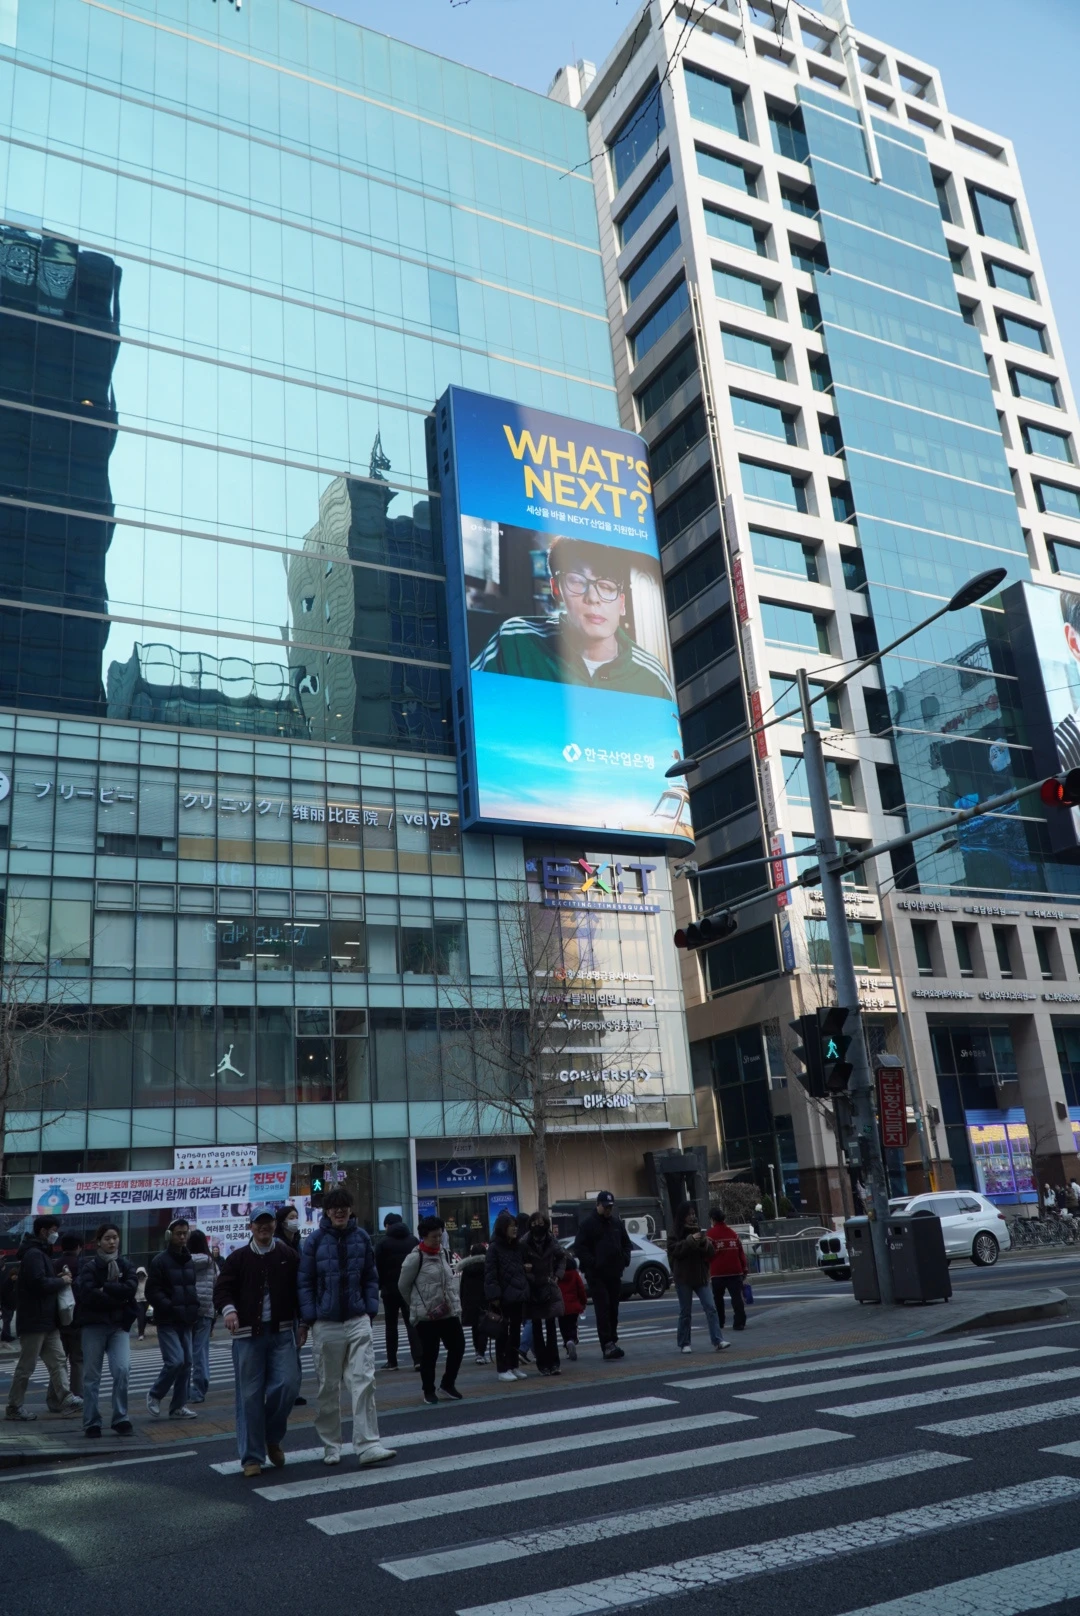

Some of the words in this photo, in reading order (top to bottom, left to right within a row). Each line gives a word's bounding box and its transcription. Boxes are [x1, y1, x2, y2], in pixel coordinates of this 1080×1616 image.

[503, 424, 651, 494] WHAT'S
[523, 465, 648, 524] NEXT?
[526, 505, 549, 518] 세상을
[550, 509, 566, 521] 바꿀
[567, 514, 589, 526] NEXT
[590, 519, 612, 532] 산업을
[613, 526, 648, 540] 지원합니다
[584, 748, 655, 770] 한국산업은행
[182, 792, 272, 815] クリニック
[293, 804, 379, 826] 维丽比医院
[404, 811, 451, 830] velyB
[581, 1022, 612, 1031] BOOKS
[559, 1068, 637, 1082] CONVERSE
[881, 1070, 904, 1145] 무단횡단금지
[176, 1152, 206, 1160] tansan
[207, 1149, 257, 1158] magnesium
[76, 1180, 129, 1191] 마포주민투표에
[130, 1179, 152, 1189] 함께해
[153, 1178, 175, 1188] 주셔서
[176, 1176, 213, 1187] 감사합니다
[253, 1171, 287, 1185] 진보당
[74, 1191, 108, 1206] 언제나
[109, 1189, 163, 1205] 주민곁에서
[166, 1187, 188, 1200] 함께
[189, 1184, 247, 1199] 하겠습니다!
[206, 1224, 231, 1233] 여러분의
[226, 1232, 250, 1241] 이곳에서
